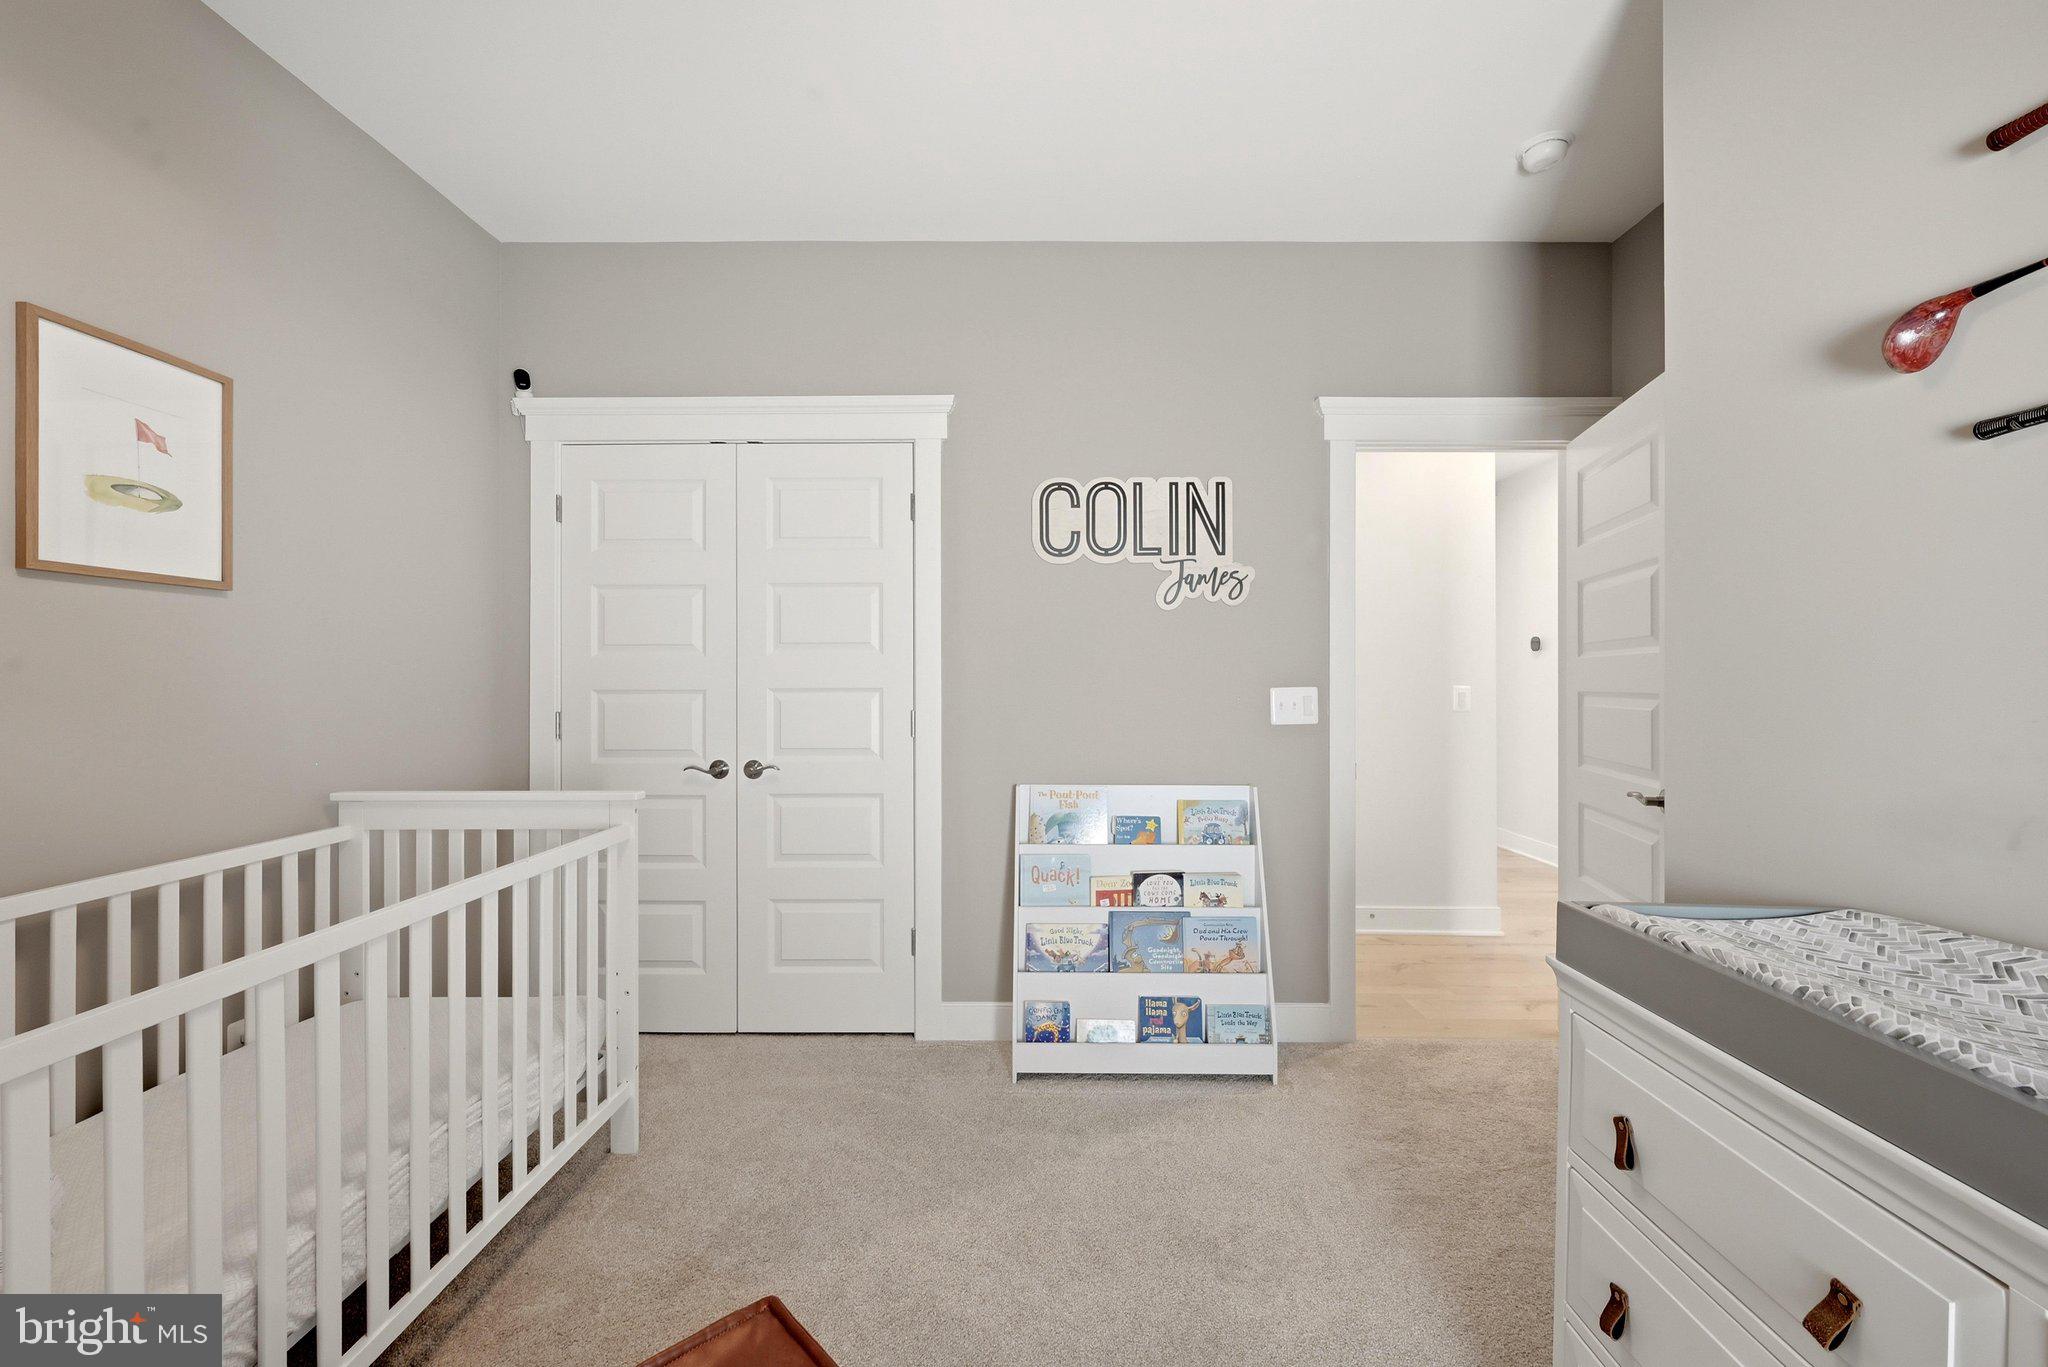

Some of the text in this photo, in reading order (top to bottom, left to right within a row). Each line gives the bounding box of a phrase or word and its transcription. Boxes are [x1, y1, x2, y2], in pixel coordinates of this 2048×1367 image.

[1039, 481, 1226, 558] COLIN
[1159, 558, 1249, 606] James
[1049, 789, 1099, 800] Pout-Pout
[1059, 800, 1079, 810] Fish
[1116, 824, 1134, 833] Spot?
[1031, 865, 1080, 887] Quack!
[1096, 879, 1117, 888] Dear
[1206, 878, 1220, 886] Blue
[1220, 878, 1238, 888] Truck
[1148, 896, 1171, 904] HOME
[1049, 927, 1065, 935] Good
[1207, 926, 1220, 935] and
[1232, 927, 1249, 935] Crew
[1040, 935, 1094, 947] Little Blue Truck
[1145, 998, 1168, 1008] llama
[1145, 1007, 1168, 1016] llama
[1216, 1010, 1263, 1020] Little Blue Truck
[1142, 1025, 1172, 1036] pajama
